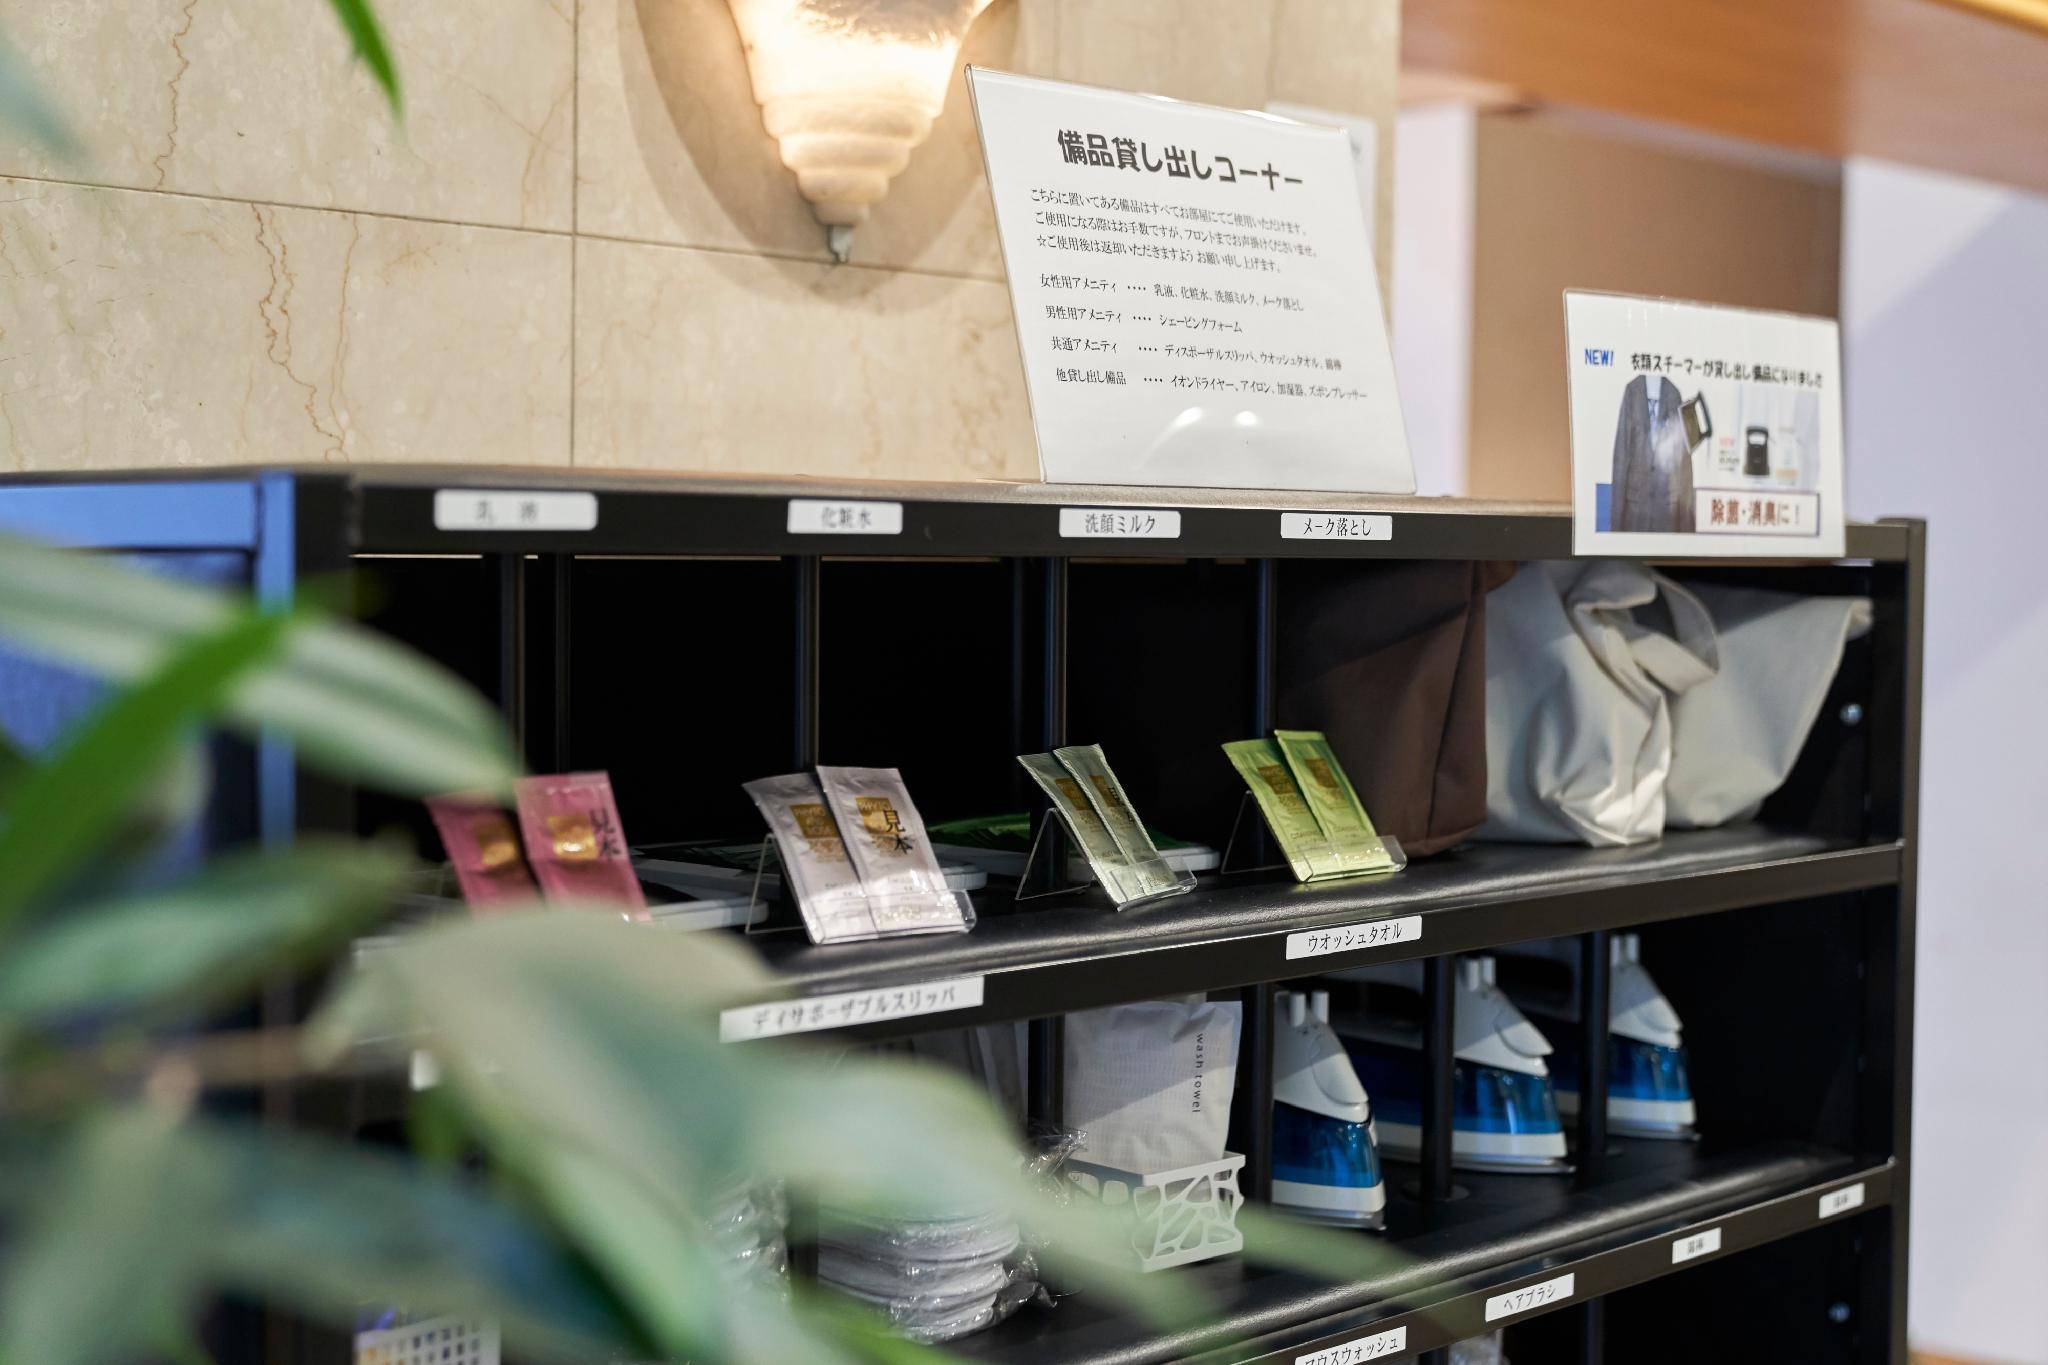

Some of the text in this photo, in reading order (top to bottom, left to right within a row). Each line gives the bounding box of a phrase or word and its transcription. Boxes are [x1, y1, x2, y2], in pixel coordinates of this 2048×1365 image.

[1057, 129, 1303, 191] 備品貸し出しコーナー
[1040, 273, 1116, 293] 女性用アメニティ
[1045, 305, 1121, 324] 男性用アメニティ
[1159, 314, 1243, 333] シェービングフォーム
[1051, 336, 1117, 353] 共通アメニティ
[1056, 367, 1127, 385] 他貸し出し備品
[1084, 512, 1156, 535] 洗顔ミルク
[1302, 518, 1372, 537] メーク落とし
[882, 807, 914, 855] 見本
[1308, 922, 1403, 953] ウオッシュタオル
[1191, 1033, 1204, 1113] wash towel
[1503, 1284, 1557, 1310] ヘアブラシ
